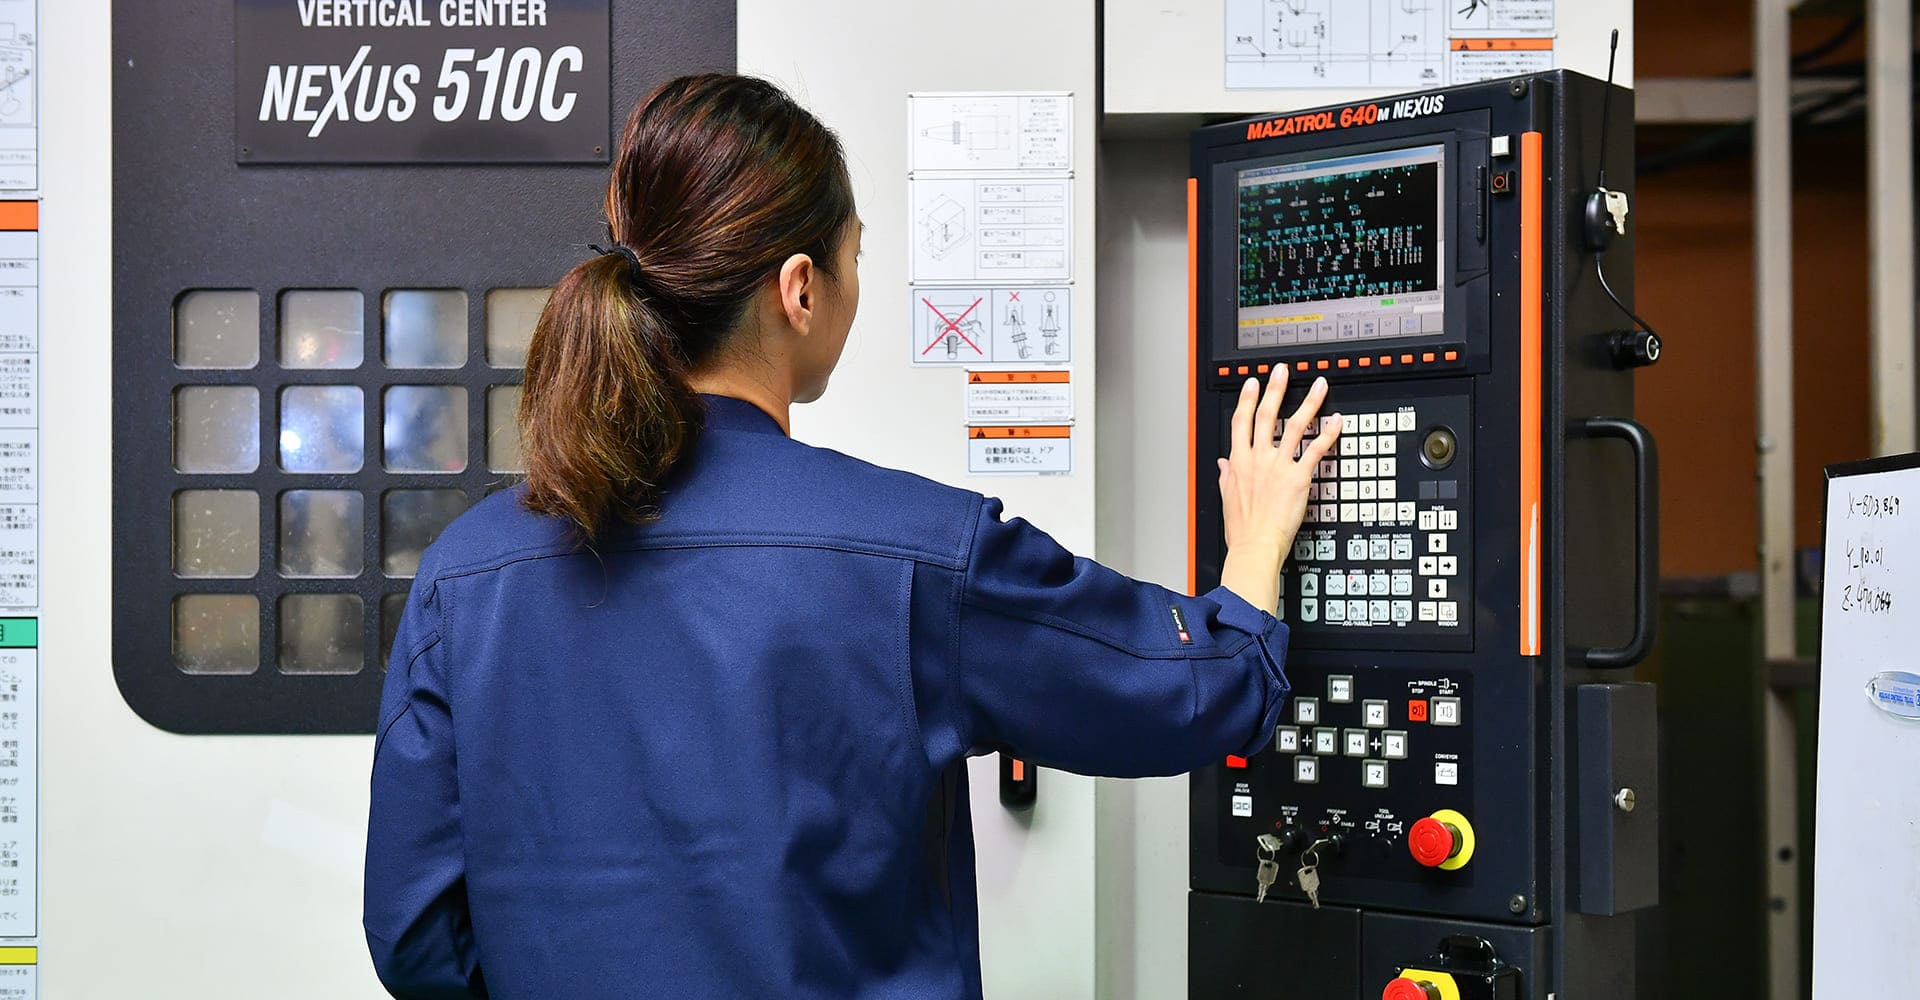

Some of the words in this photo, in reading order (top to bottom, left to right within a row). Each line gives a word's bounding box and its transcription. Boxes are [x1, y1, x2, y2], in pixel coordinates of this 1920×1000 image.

[298, 0, 431, 27] VERTICAL
[440, 0, 547, 27] CENTER
[258, 45, 421, 138] NEXUS
[432, 45, 583, 122] 510C
[1246, 113, 1336, 141] MAZATROL
[1392, 95, 1445, 120] NEXUS
[1346, 420, 1352, 428] 7
[1365, 419, 1371, 428] 8
[1384, 418, 1390, 427] 9
[1346, 442, 1352, 450] 4
[1365, 441, 1371, 450] 5
[1384, 440, 1390, 449] 6
[985, 446, 1054, 455] 自動運転中は、ドア
[985, 456, 1042, 464] を開けないこと。
[1365, 463, 1371, 472] 2
[1384, 463, 1390, 472] 3
[1325, 487, 1331, 496] L
[1325, 509, 1331, 517] B
[1371, 710, 1381, 719] +Z
[1284, 736, 1294, 745] +X
[1321, 738, 1331, 746] -X
[1352, 740, 1361, 748] +4
[1391, 741, 1400, 749] -4
[1302, 766, 1312, 775] +Y
[1371, 770, 1381, 779] -Z
